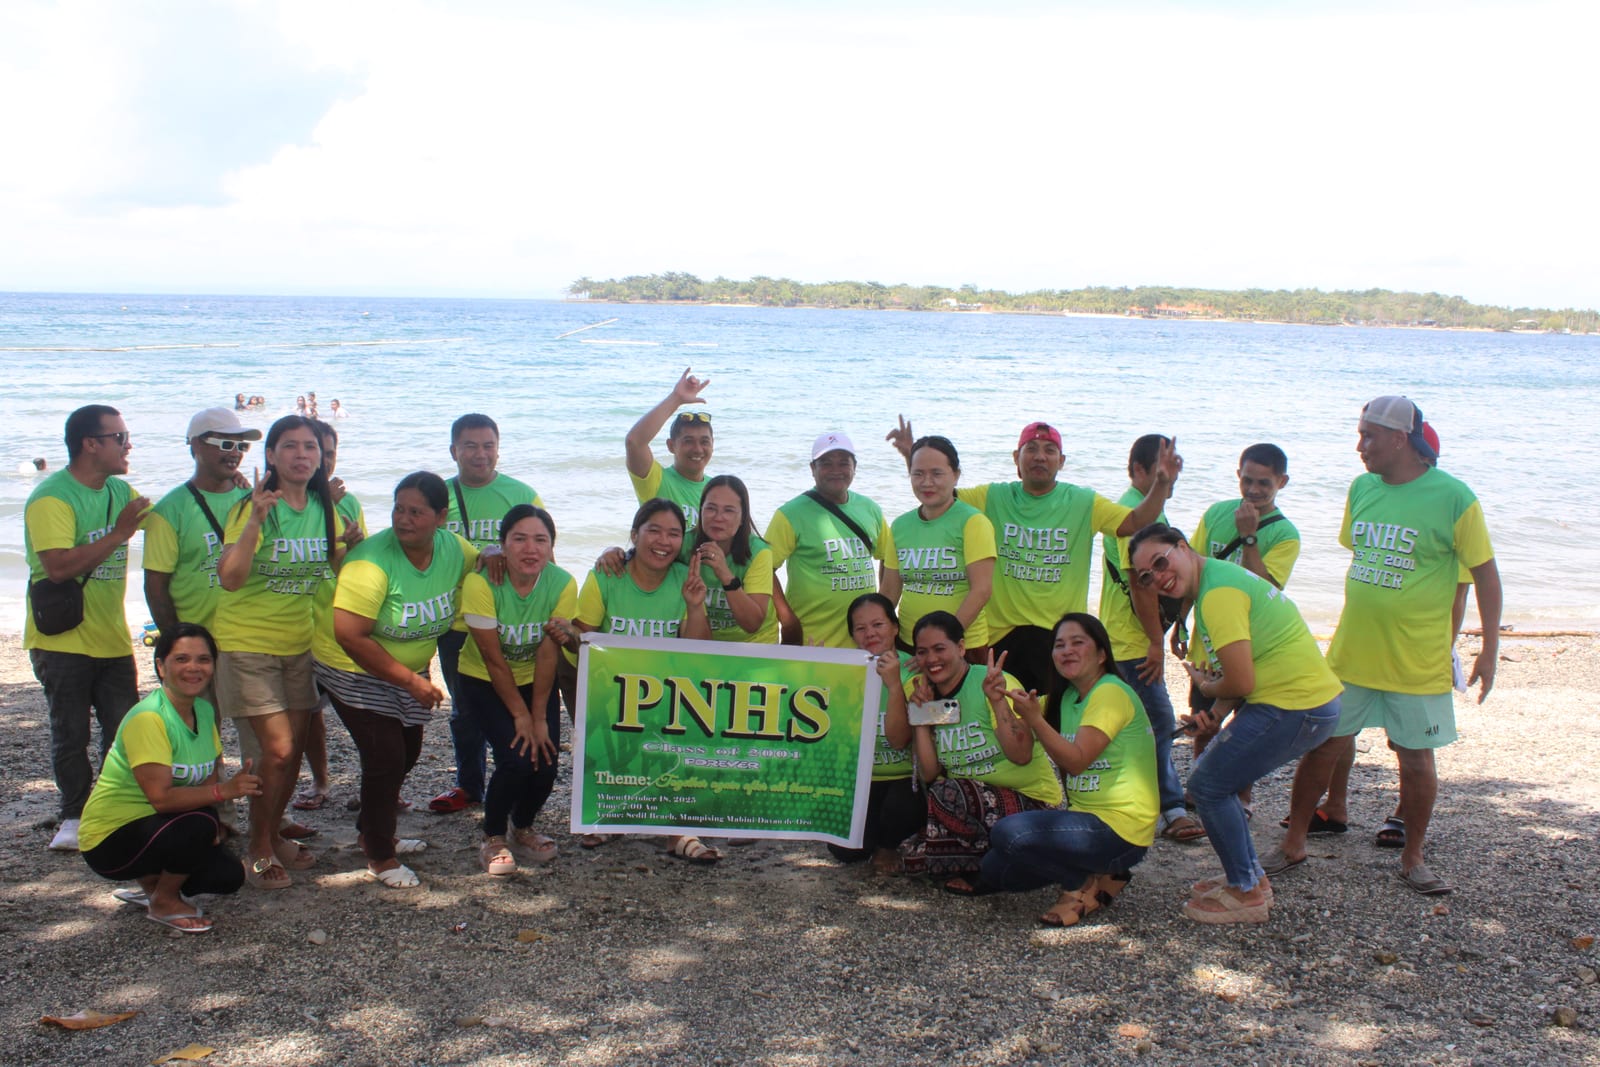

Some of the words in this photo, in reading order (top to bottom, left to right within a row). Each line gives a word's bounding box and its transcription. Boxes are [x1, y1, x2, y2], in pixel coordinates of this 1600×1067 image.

[1004, 522, 1069, 551] PNHS
[1352, 521, 1419, 555] PNHS
[897, 546, 958, 570] PNHS
[1043, 553, 1071, 564] 2001
[1383, 554, 1416, 571] 2001
[265, 579, 320, 595] FOREV
[831, 573, 876, 591] FOREV
[1349, 563, 1404, 590] OREVER
[498, 621, 548, 646] NH
[609, 615, 681, 638] PNHS
[612, 673, 831, 743] PNHS
[935, 721, 987, 753] NHS
[642, 742, 706, 754] Class
[715, 747, 740, 757] of
[748, 748, 801, 760] 2001
[965, 745, 1001, 764] 2001
[684, 757, 761, 770] FOREVER
[594, 770, 652, 786] Theme:
